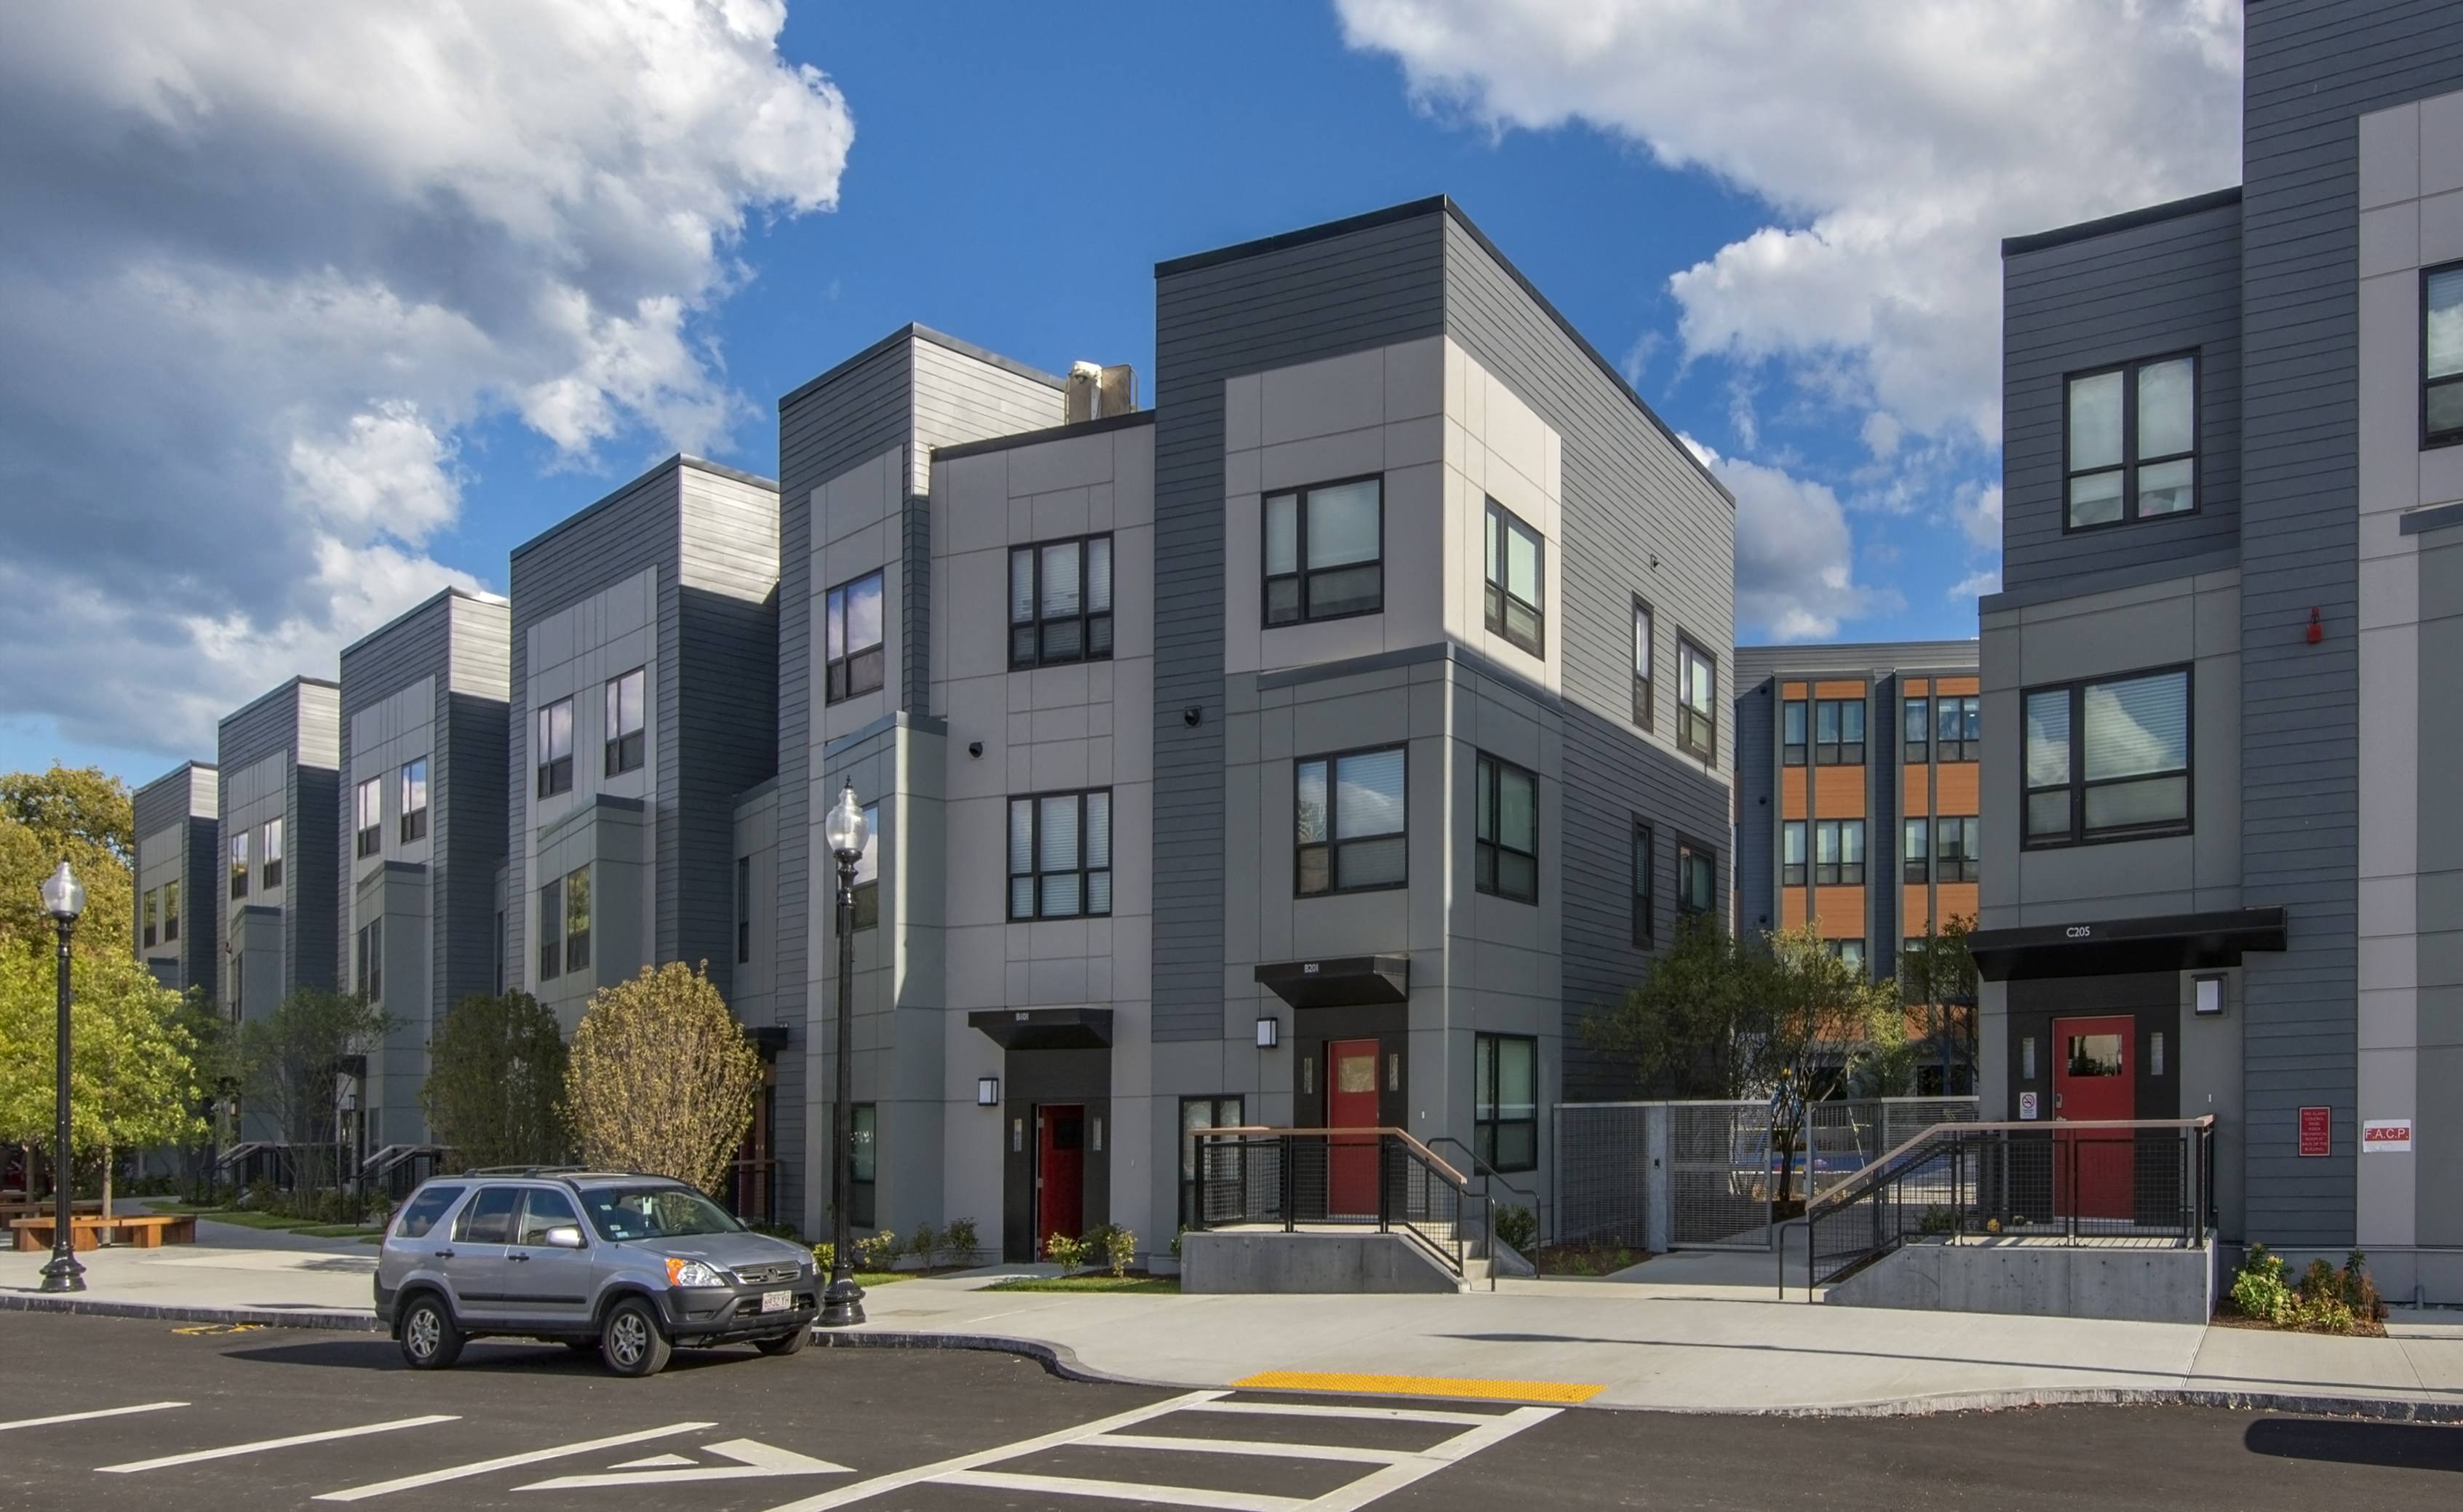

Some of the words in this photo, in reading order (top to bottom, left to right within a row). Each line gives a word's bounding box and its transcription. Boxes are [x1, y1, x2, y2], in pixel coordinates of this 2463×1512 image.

[2066, 926, 2090, 937] C205
[1305, 963, 1318, 973] B201
[1016, 1012, 1029, 1021] B101
[2365, 1129, 2408, 1139] F.A.C.P.
